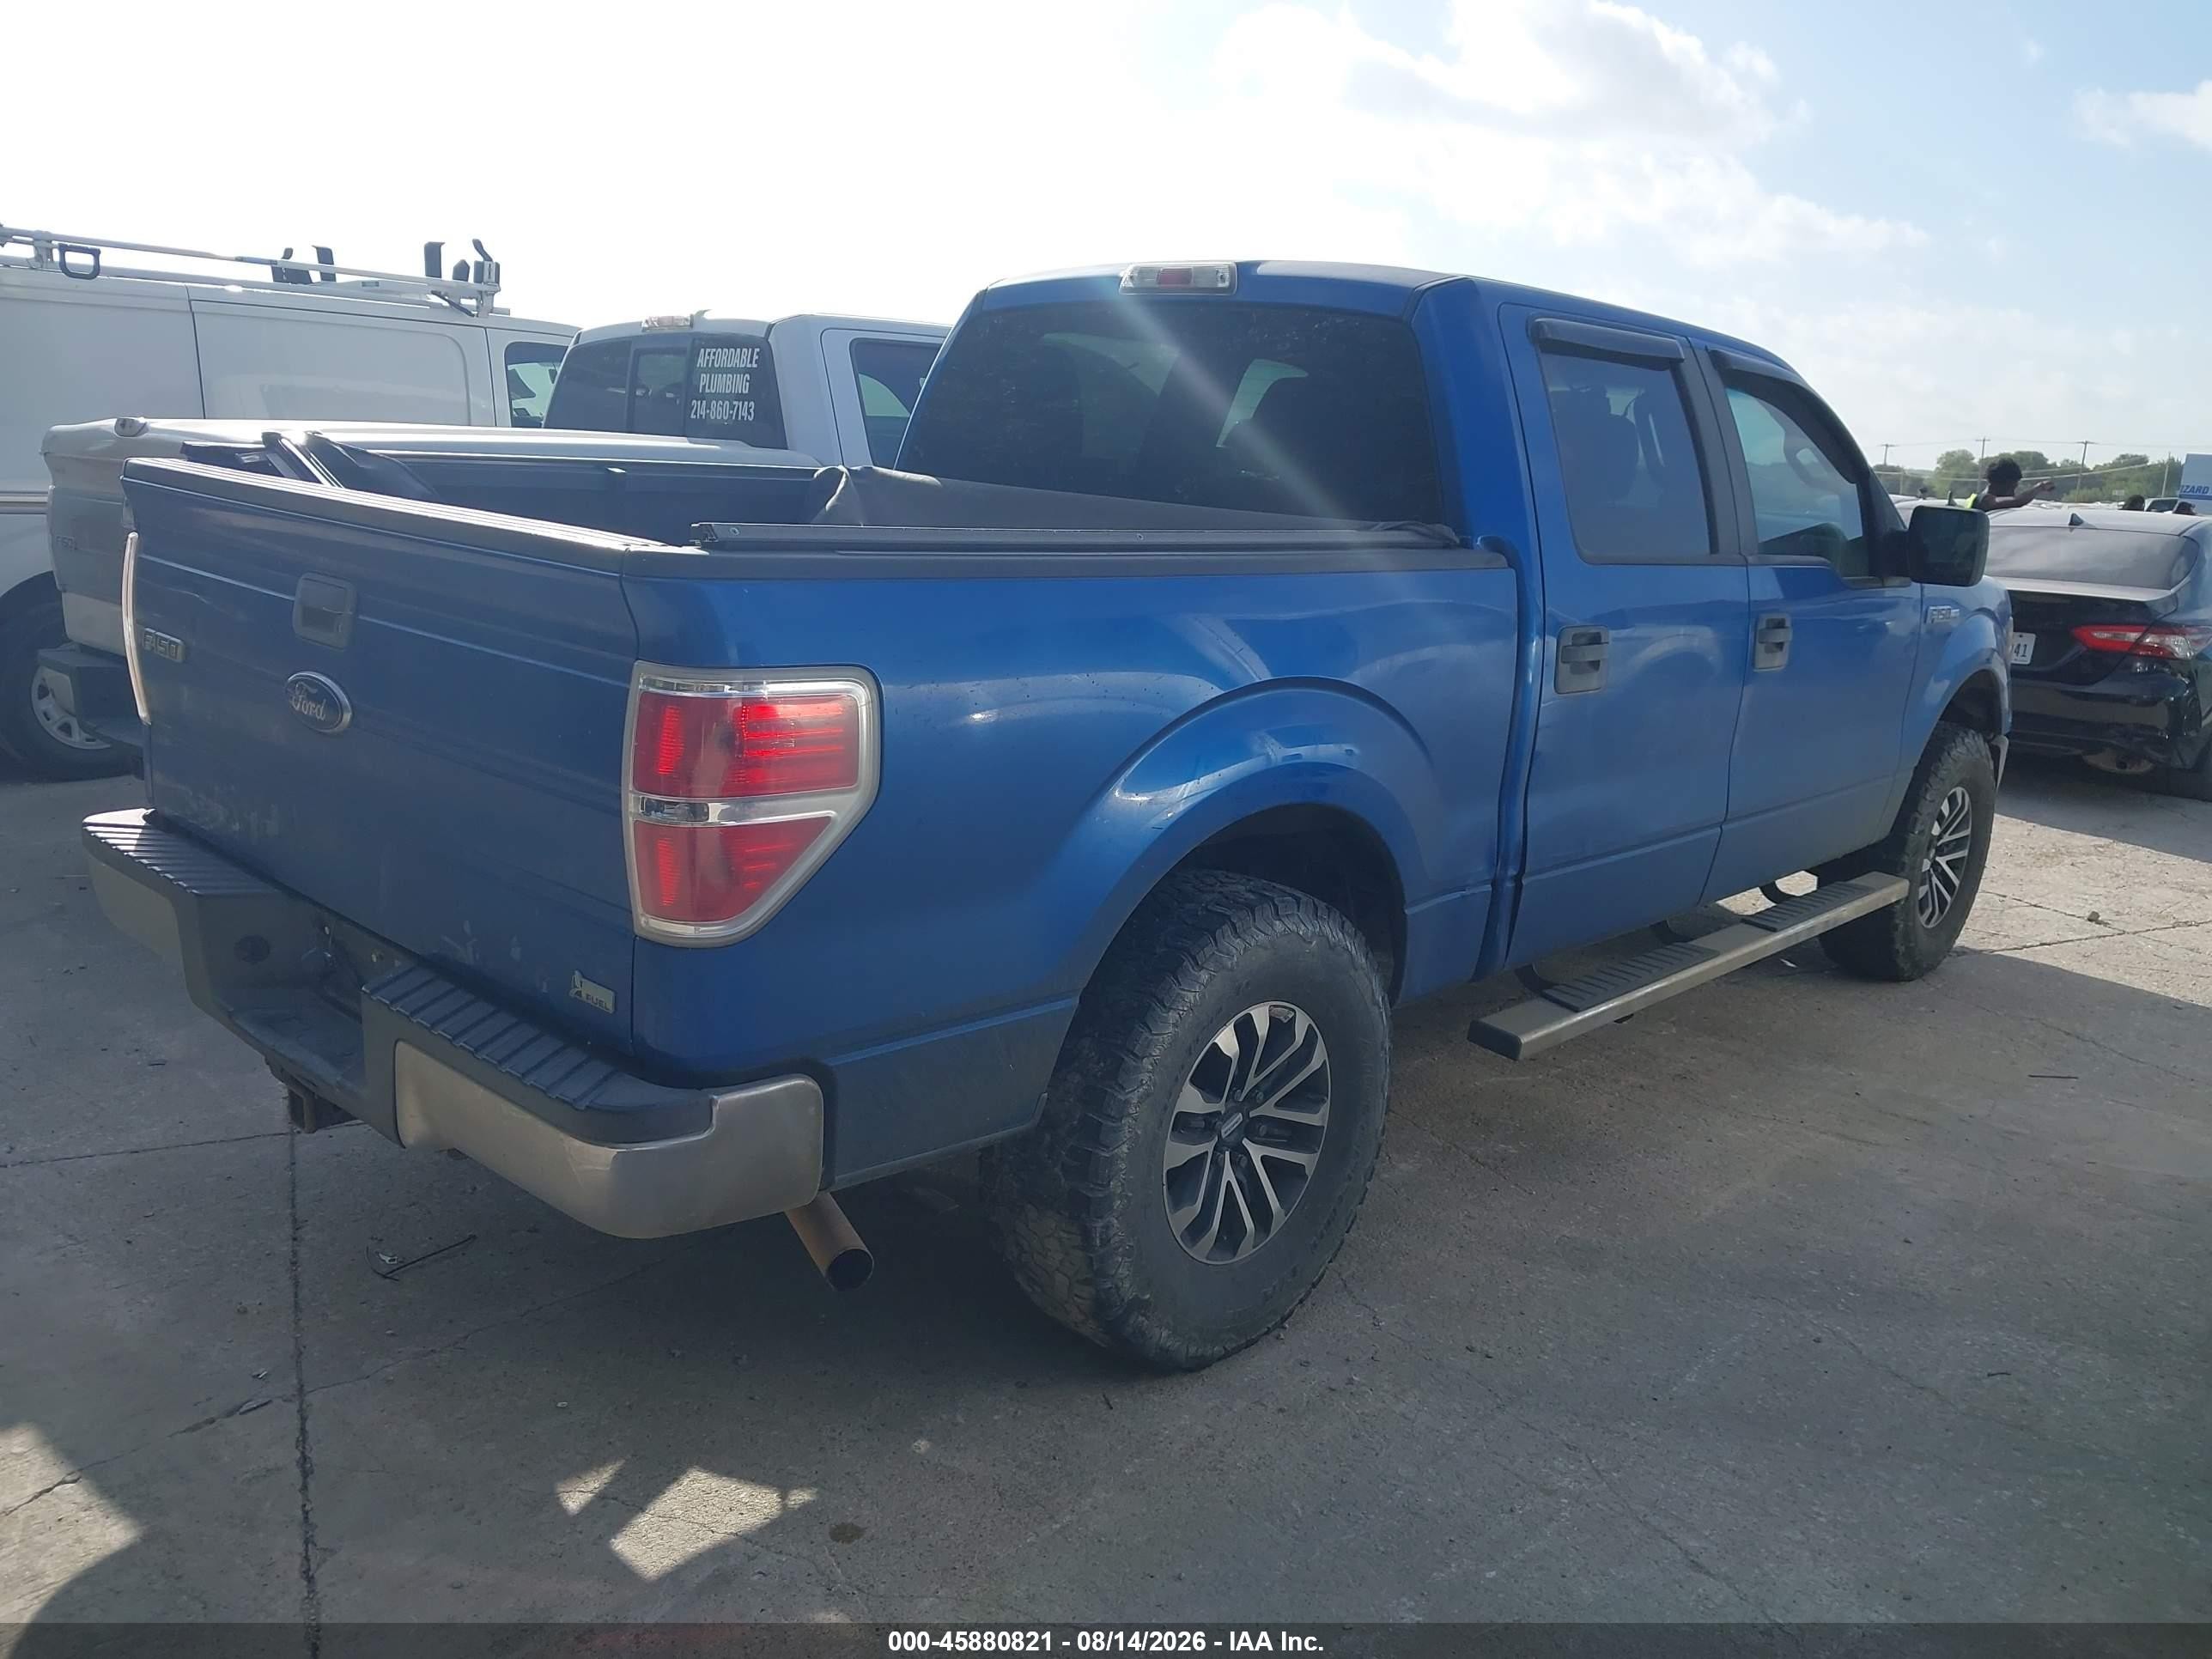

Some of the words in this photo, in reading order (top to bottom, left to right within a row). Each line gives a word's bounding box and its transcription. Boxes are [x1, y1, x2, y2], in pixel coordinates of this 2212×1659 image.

[696, 348, 760, 368] AFFORDABLE
[699, 374, 750, 394] PLUMBING
[690, 399, 755, 421] 214-860-7143
[2010, 643, 2027, 659] 41
[290, 681, 326, 721] Ford
